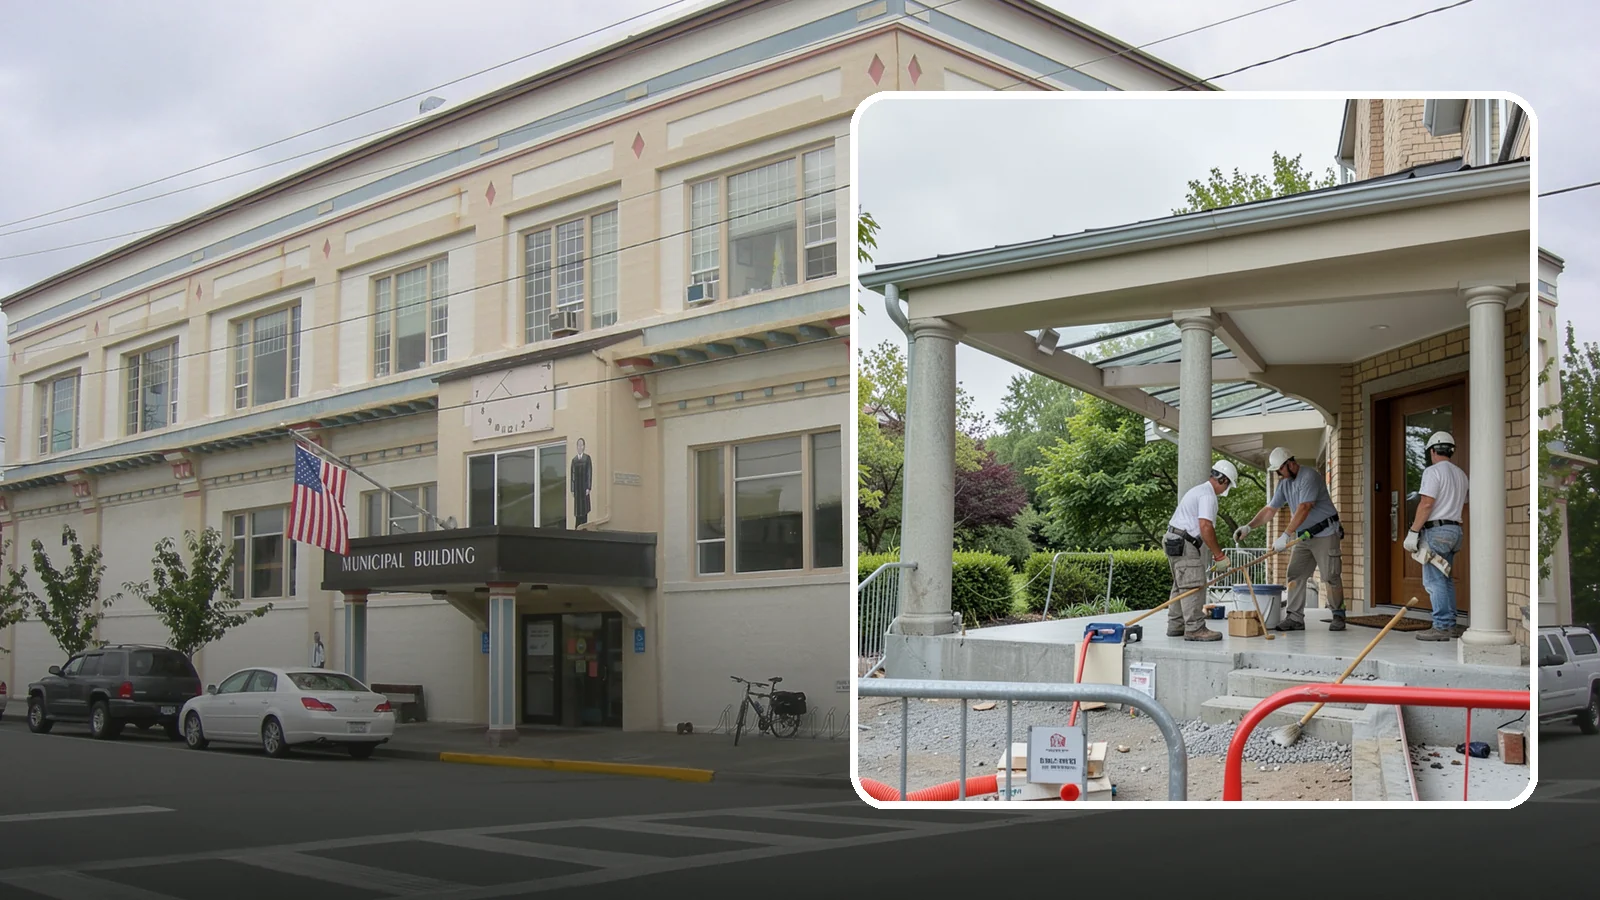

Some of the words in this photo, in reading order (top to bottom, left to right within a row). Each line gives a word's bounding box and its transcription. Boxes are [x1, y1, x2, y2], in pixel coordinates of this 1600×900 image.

[480, 406, 484, 414] 8
[536, 402, 540, 410] 4
[488, 418, 492, 426] 9
[528, 414, 532, 422] 3
[494, 424, 500, 432] 10
[521, 420, 525, 428] 2
[508, 425, 513, 433] 12
[342, 552, 405, 572] MUNICIPAL
[414, 546, 475, 567] BUILDING
